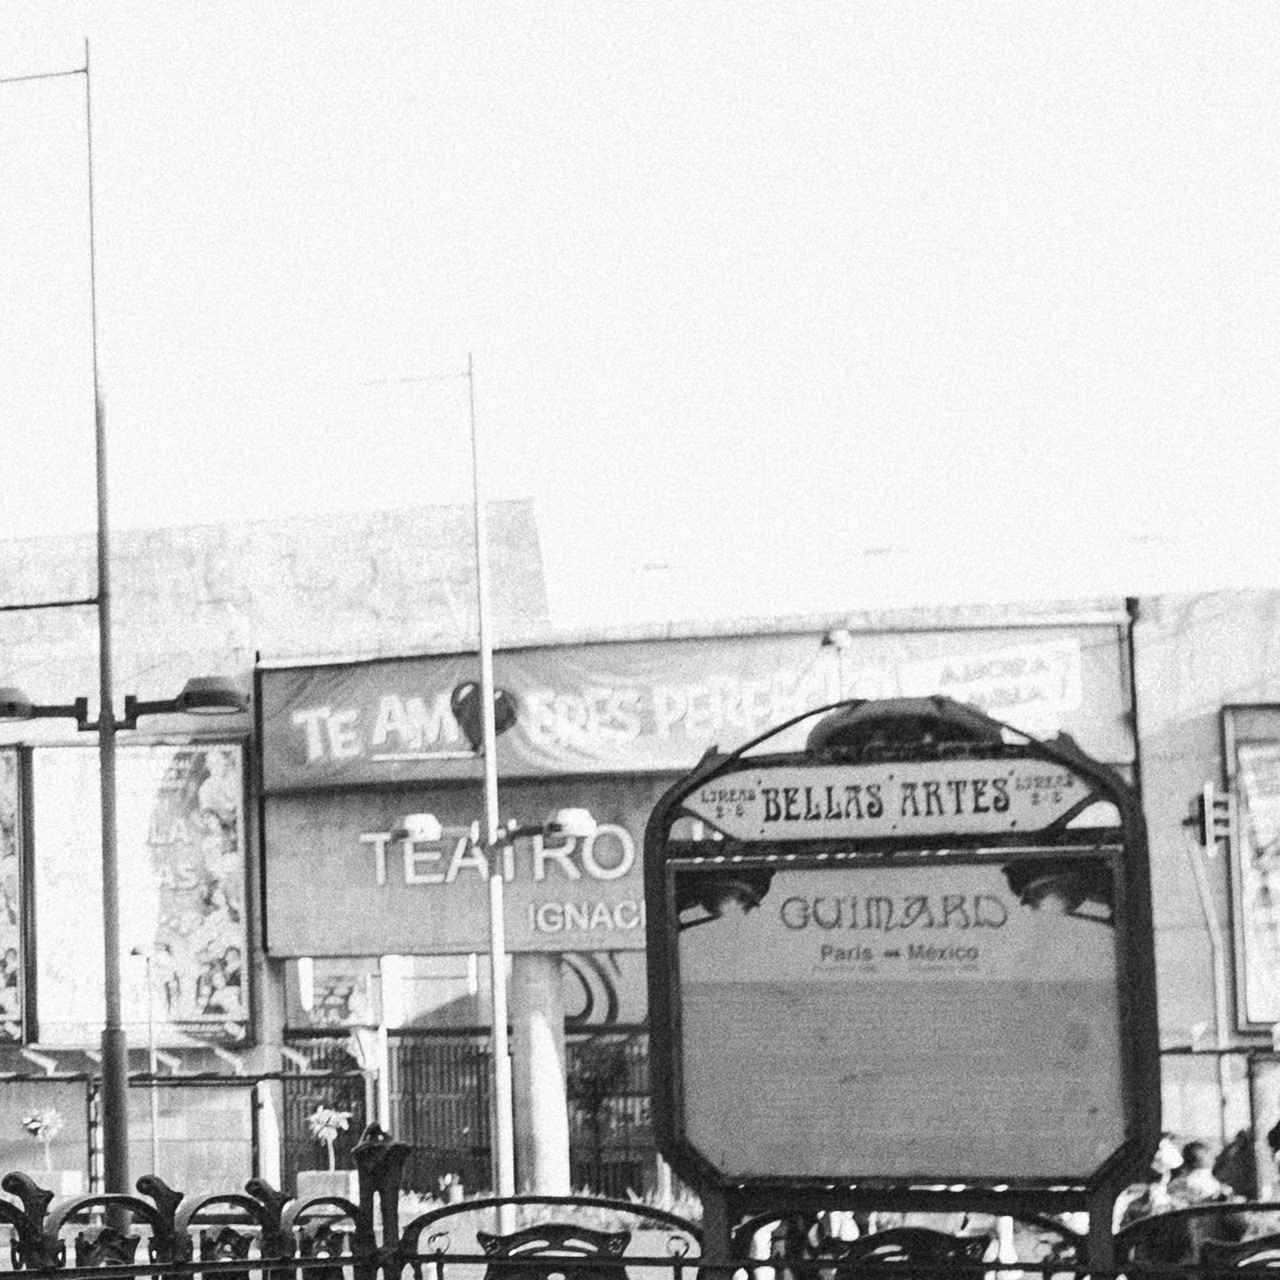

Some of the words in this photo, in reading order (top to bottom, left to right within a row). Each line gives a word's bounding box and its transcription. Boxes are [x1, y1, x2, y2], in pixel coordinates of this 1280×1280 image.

[291, 706, 362, 762] TE
[761, 784, 884, 823] BELLAS
[900, 778, 1010, 818] ARTES
[359, 823, 635, 885] TEATRO
[780, 894, 1009, 932] GUIMARD
[821, 944, 873, 961] Paris
